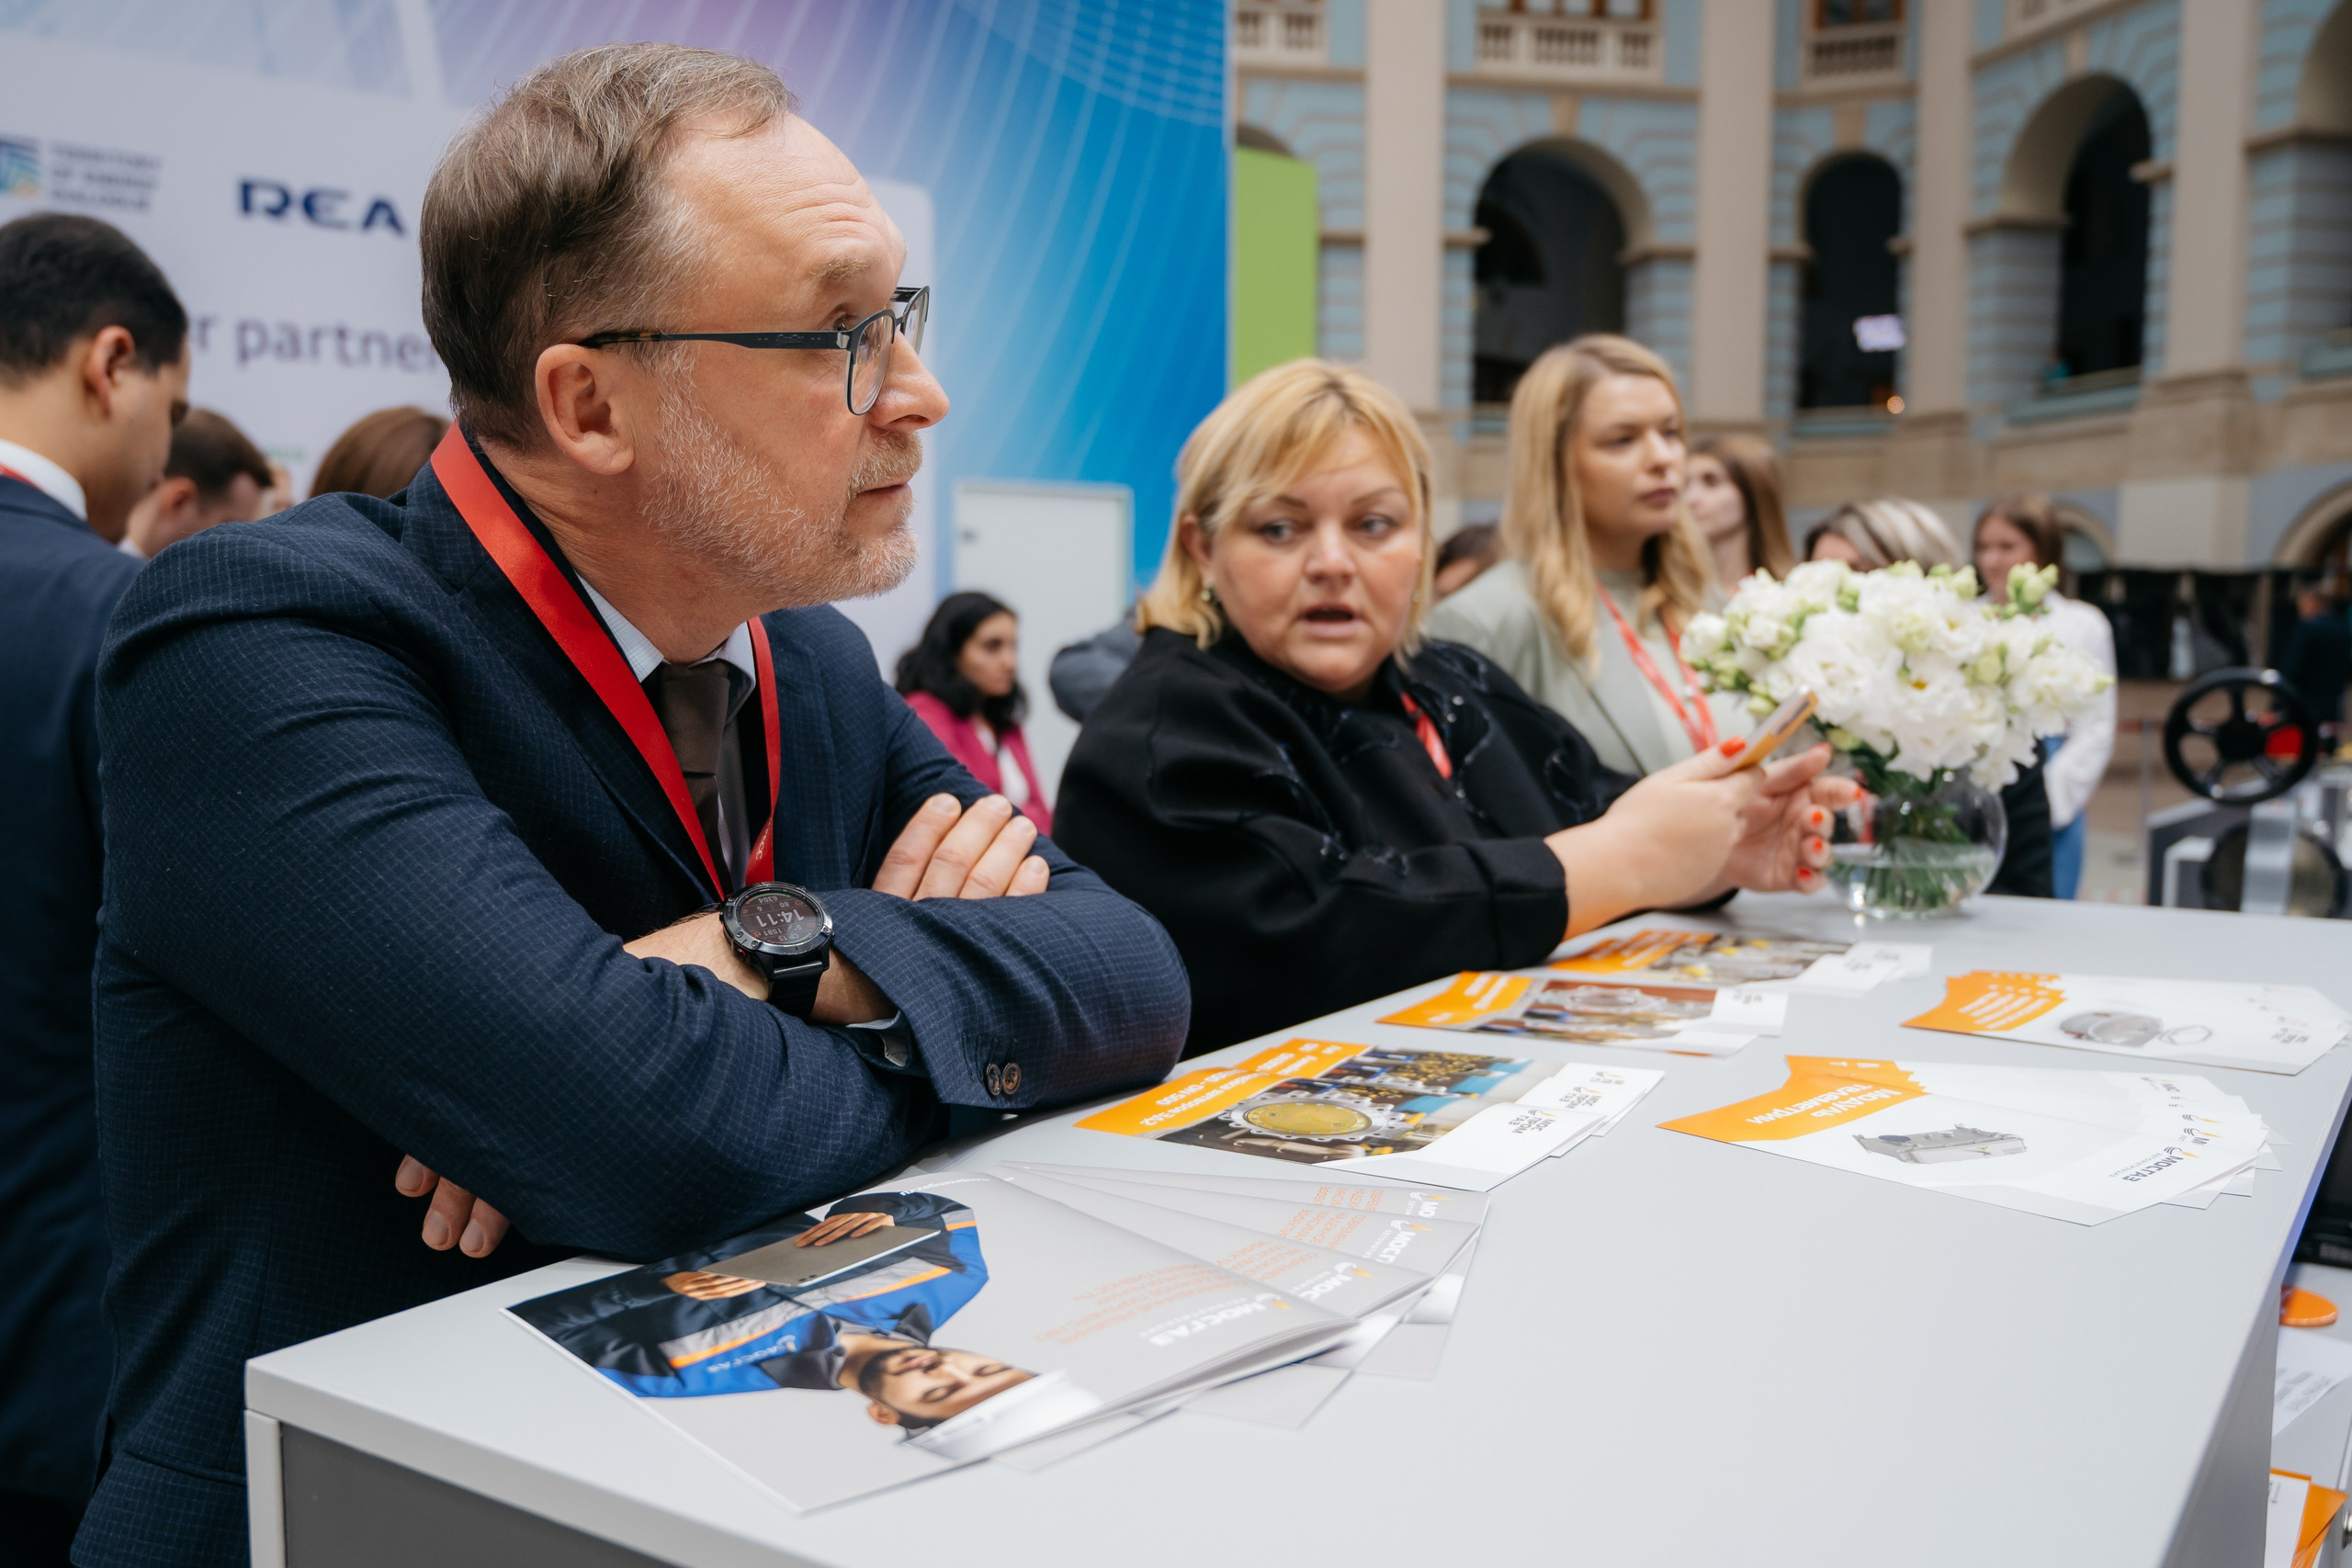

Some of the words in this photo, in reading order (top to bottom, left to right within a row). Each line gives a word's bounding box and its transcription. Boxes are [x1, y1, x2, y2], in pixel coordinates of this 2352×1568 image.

[755, 908, 805, 928] 14:11
[1745, 1083, 1873, 1124] телеметрии
[1810, 1088, 1902, 1119] Модуль
[1508, 1114, 1530, 1126] ГАЗ
[1511, 1117, 1543, 1134] ПРОМ
[1530, 1118, 1556, 1132] МОС
[2121, 1156, 2184, 1182] МОСГАЗ
[1148, 1300, 1267, 1347] МОСГАЗ
